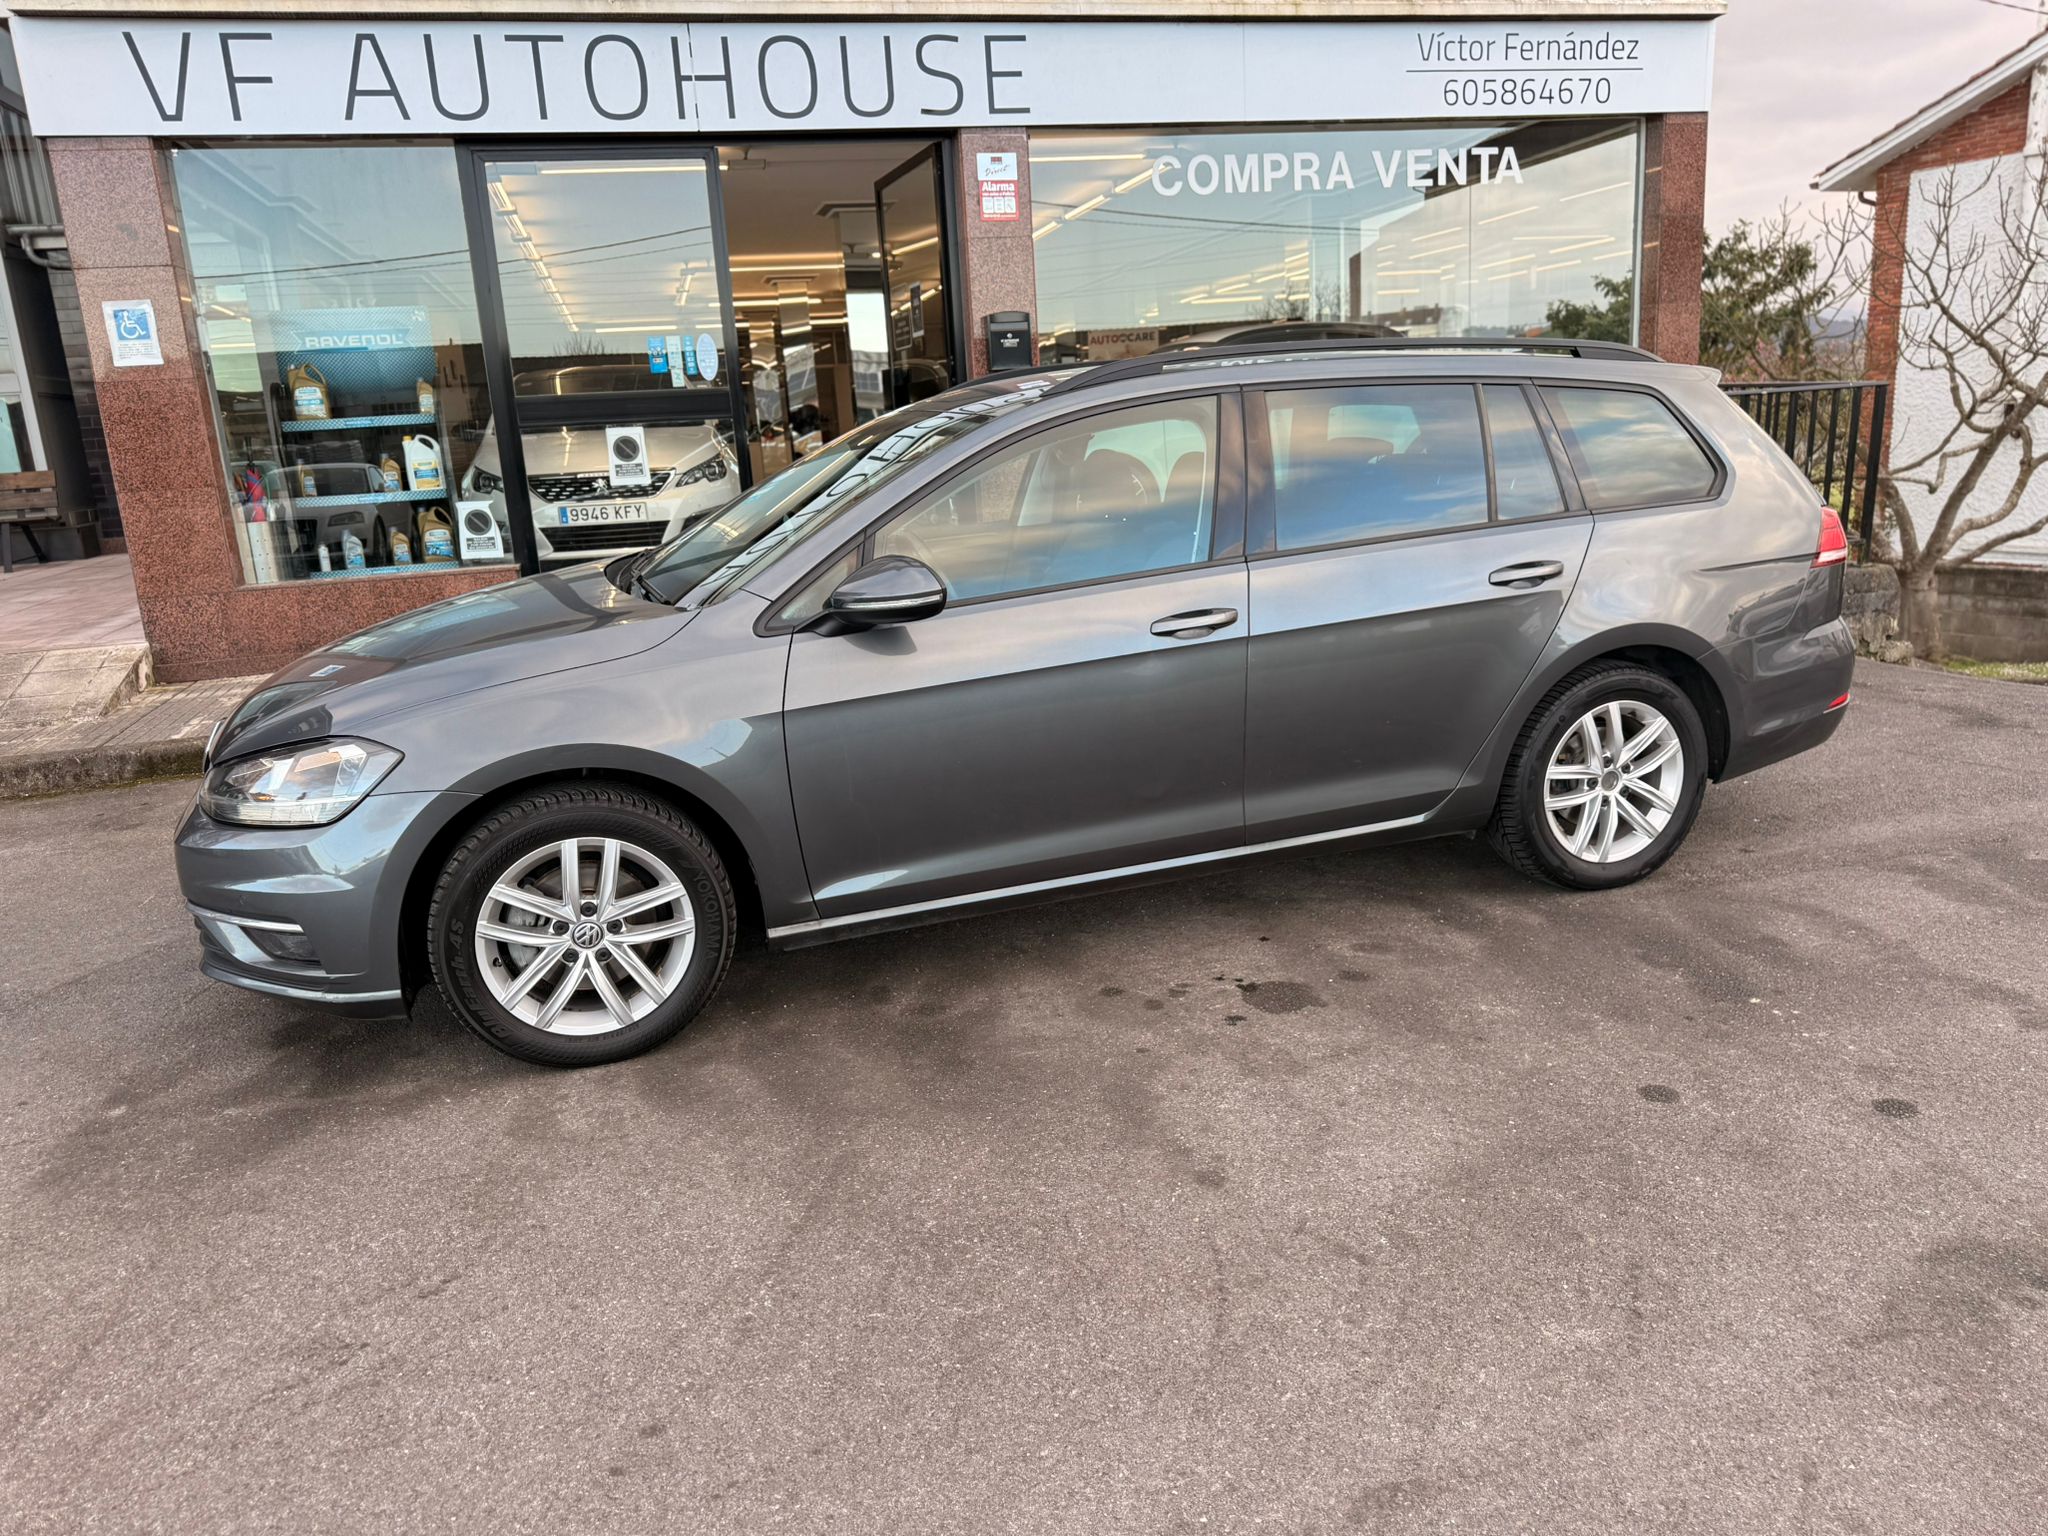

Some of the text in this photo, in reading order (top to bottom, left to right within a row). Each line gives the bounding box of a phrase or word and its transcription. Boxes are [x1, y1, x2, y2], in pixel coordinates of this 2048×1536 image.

[1416, 31, 1640, 61] Víctor Fernández
[121, 31, 1031, 122] VF AUTOHOUSE
[1443, 77, 1612, 106] 605864670
[981, 181, 1015, 191] Alarma
[1151, 146, 1525, 197] COMPRA VENTA
[304, 333, 405, 349] RAVENOL
[569, 506, 609, 522] 9946
[613, 504, 643, 520] KFY
